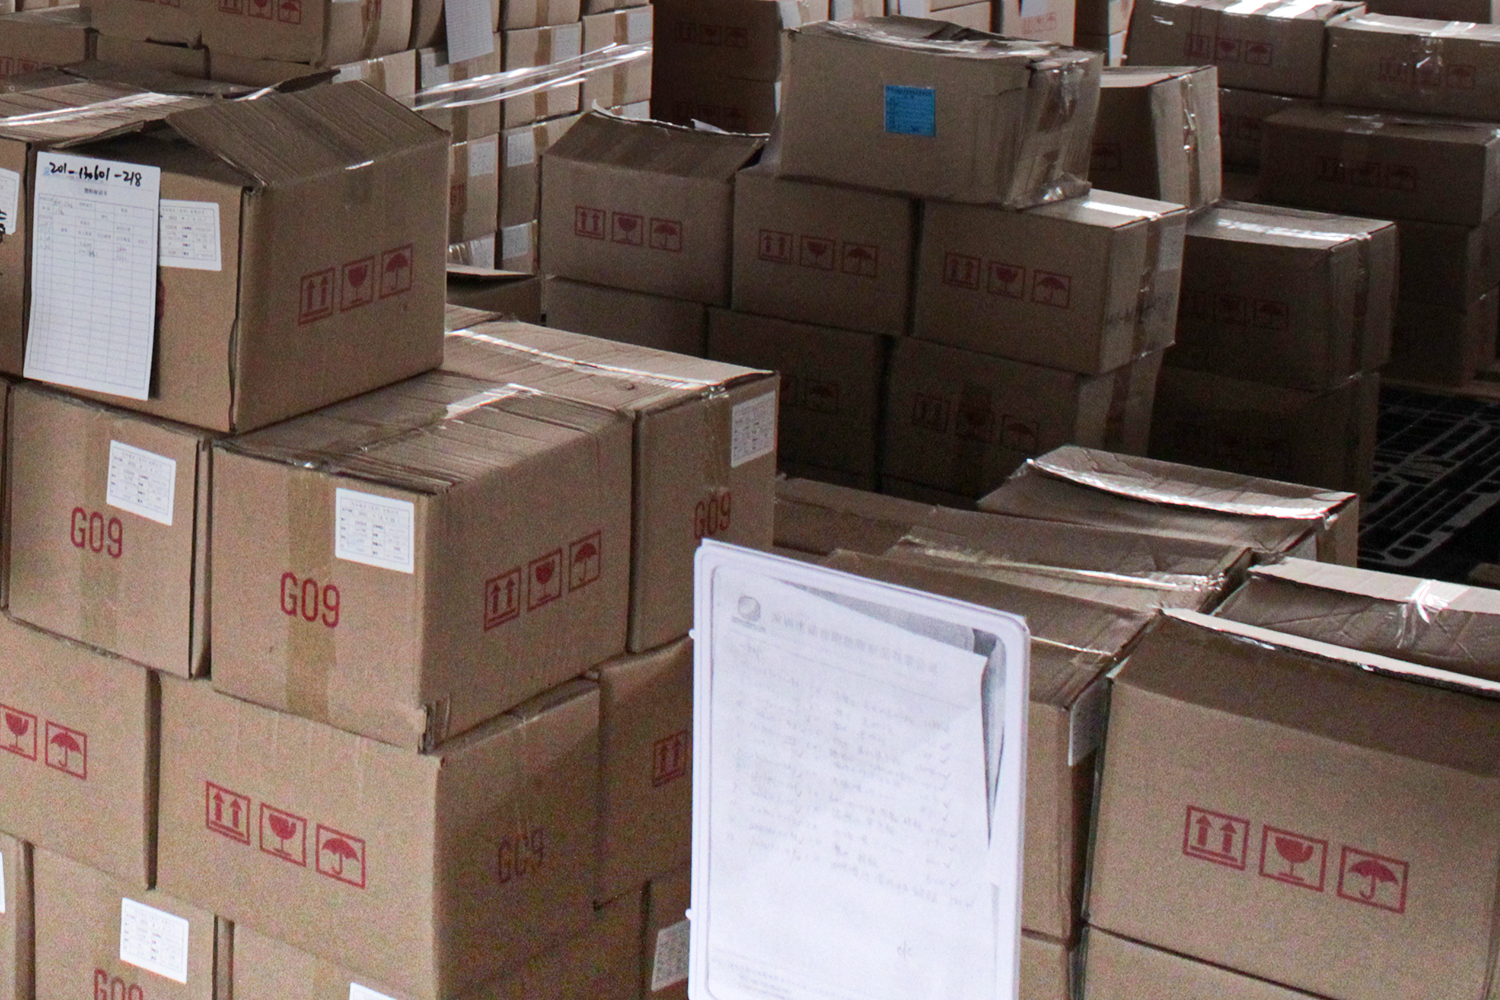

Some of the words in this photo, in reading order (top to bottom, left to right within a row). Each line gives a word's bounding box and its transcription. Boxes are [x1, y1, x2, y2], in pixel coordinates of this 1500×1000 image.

[71, 506, 123, 558] G09
[695, 491, 732, 539] G09
[280, 572, 341, 628] G09
